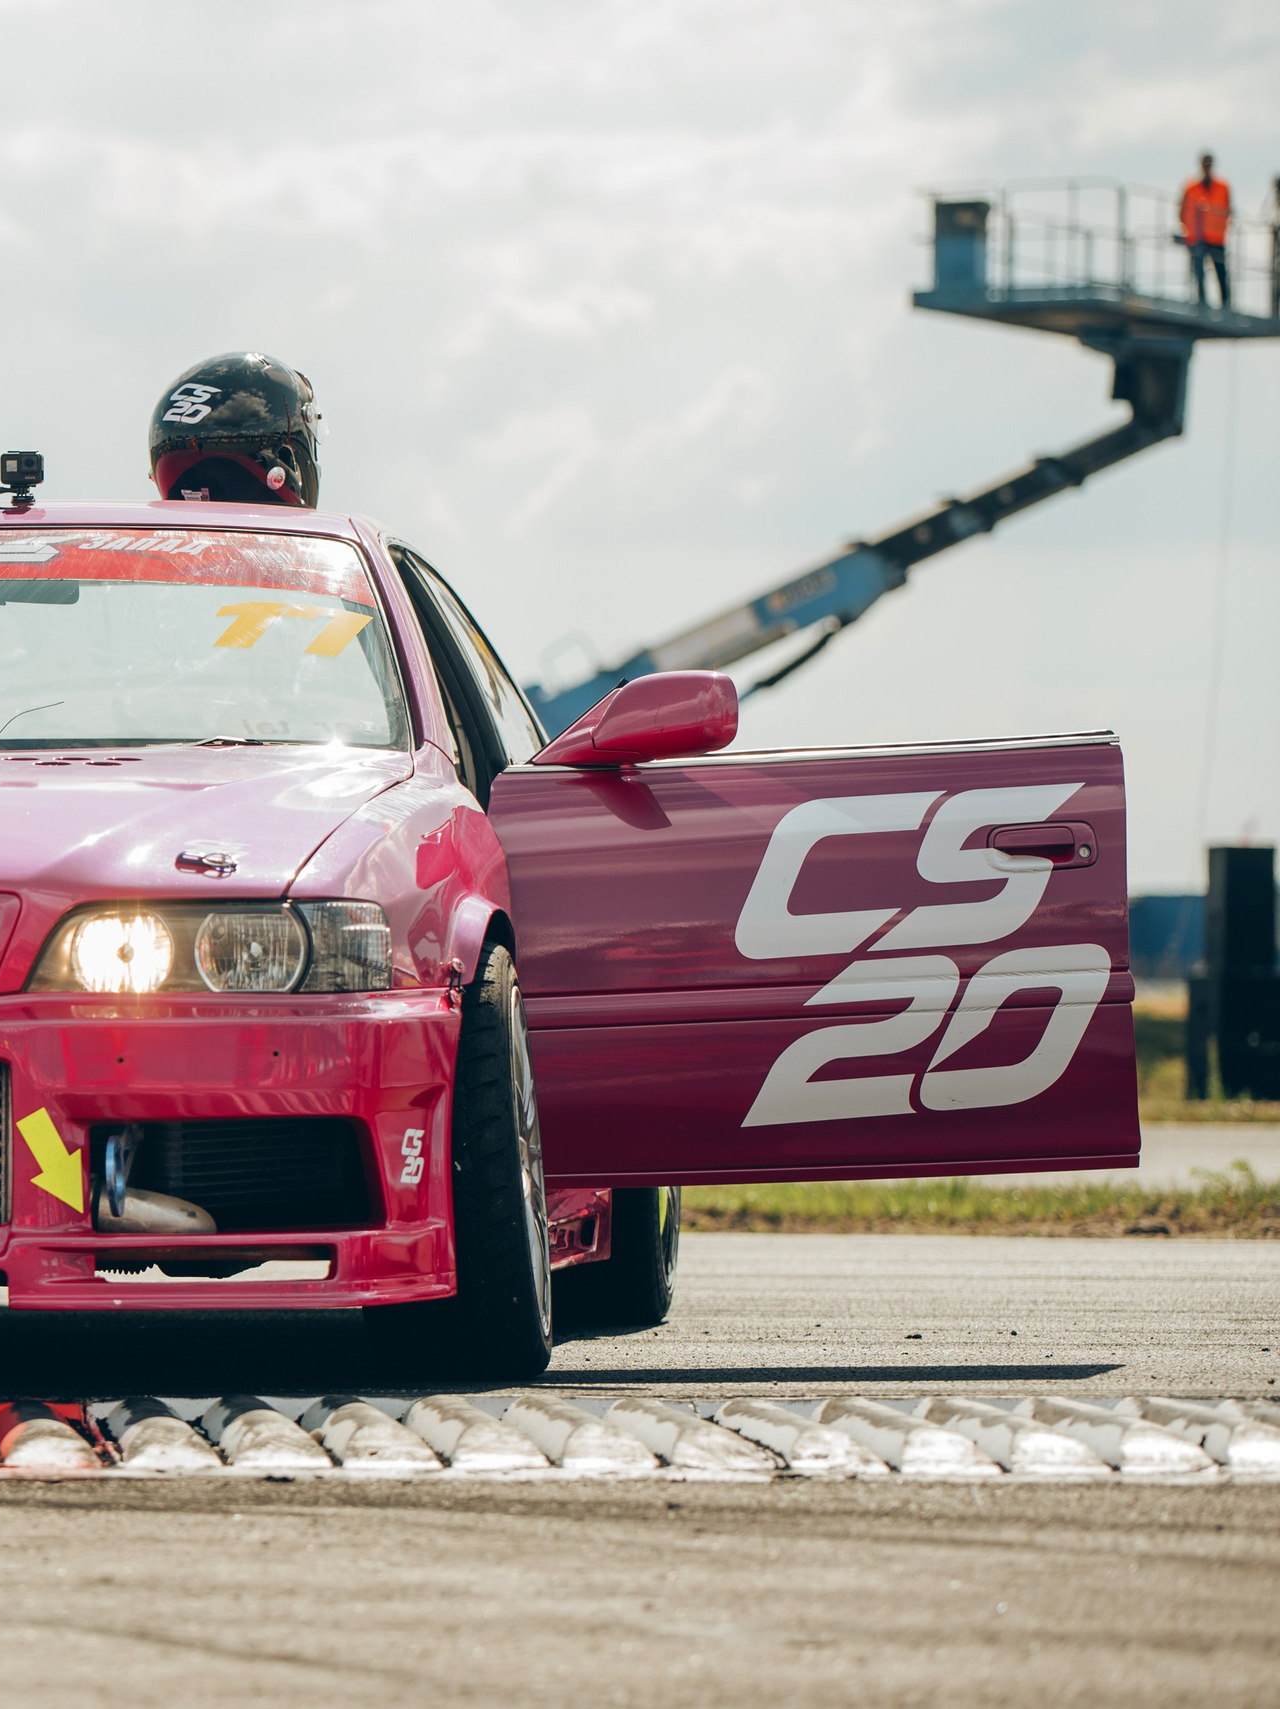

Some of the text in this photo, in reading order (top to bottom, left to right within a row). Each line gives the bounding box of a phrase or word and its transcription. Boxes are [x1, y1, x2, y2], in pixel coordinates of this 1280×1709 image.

[170, 382, 222, 403] CS
[162, 401, 212, 424] 20
[79, 536, 210, 556] ЗАПАД
[734, 782, 1086, 960] CS
[740, 943, 1112, 1128] 20
[401, 1128, 425, 1157] CS
[400, 1155, 425, 1184] 20
